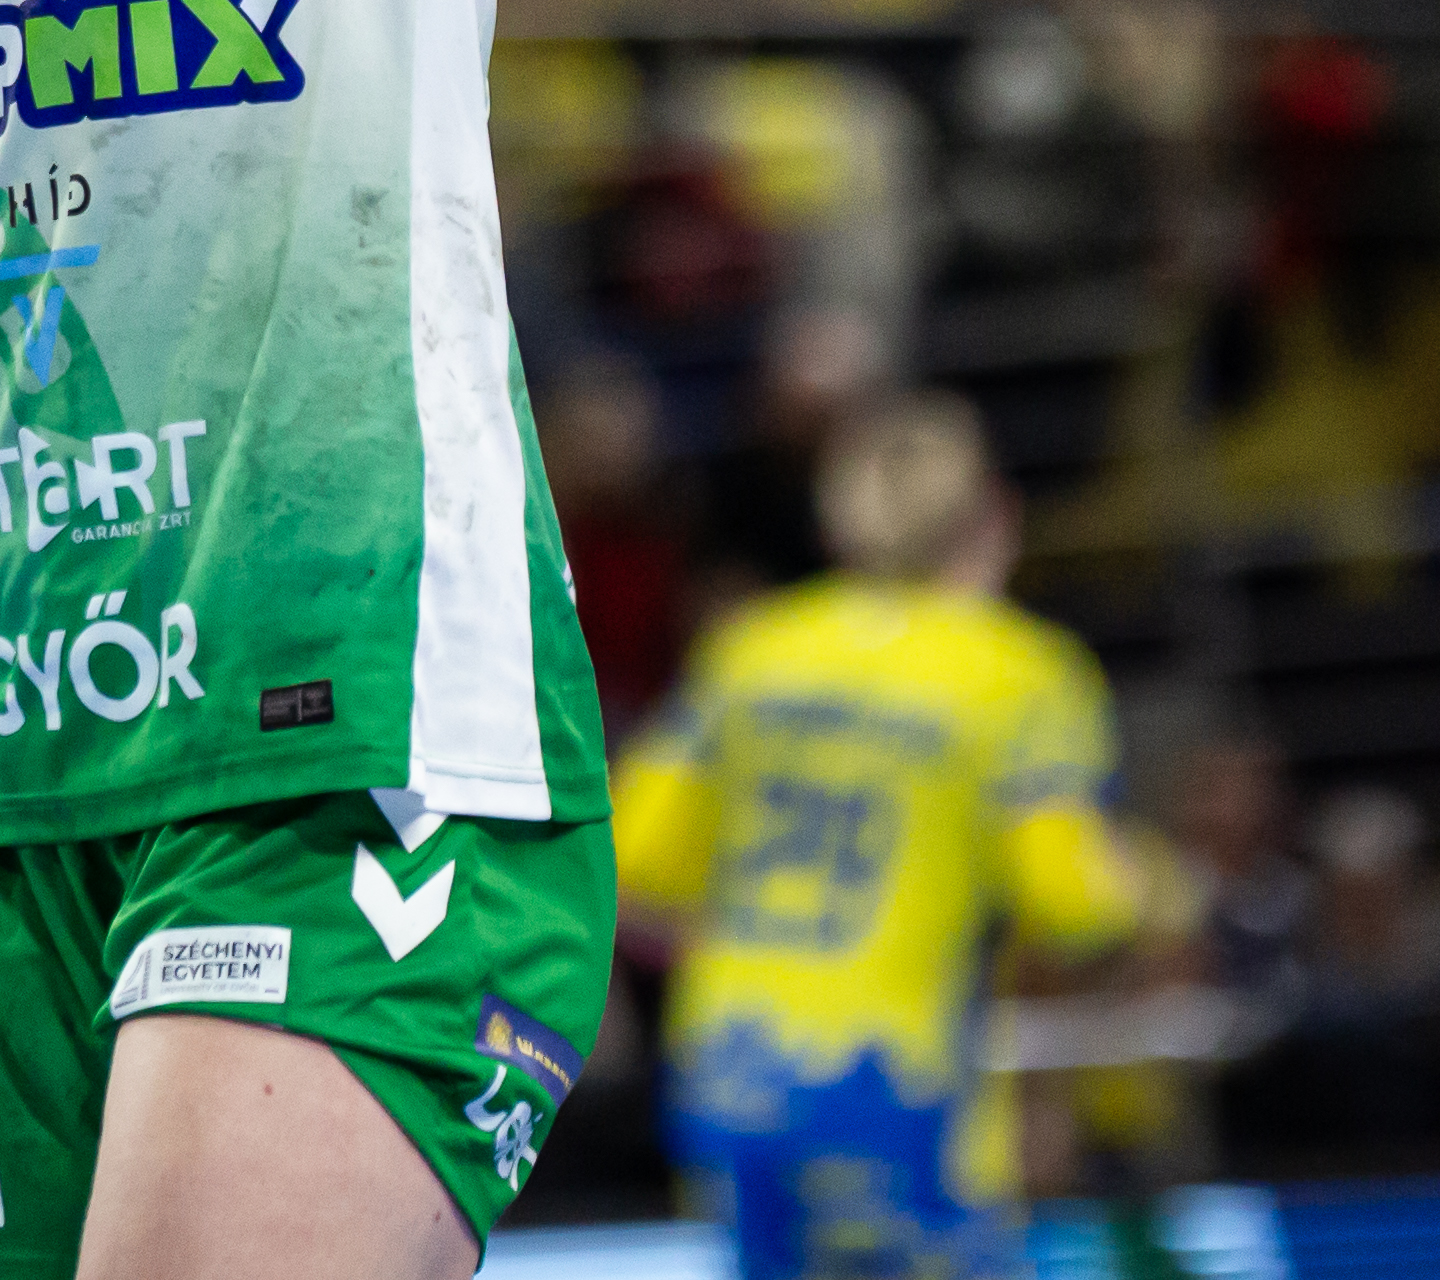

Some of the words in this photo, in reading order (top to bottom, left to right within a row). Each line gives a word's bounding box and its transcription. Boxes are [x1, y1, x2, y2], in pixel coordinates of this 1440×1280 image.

[70, 517, 154, 544] GARANC
[163, 938, 283, 962] SZÉCHENYI
[162, 962, 261, 983] EGYETEM
